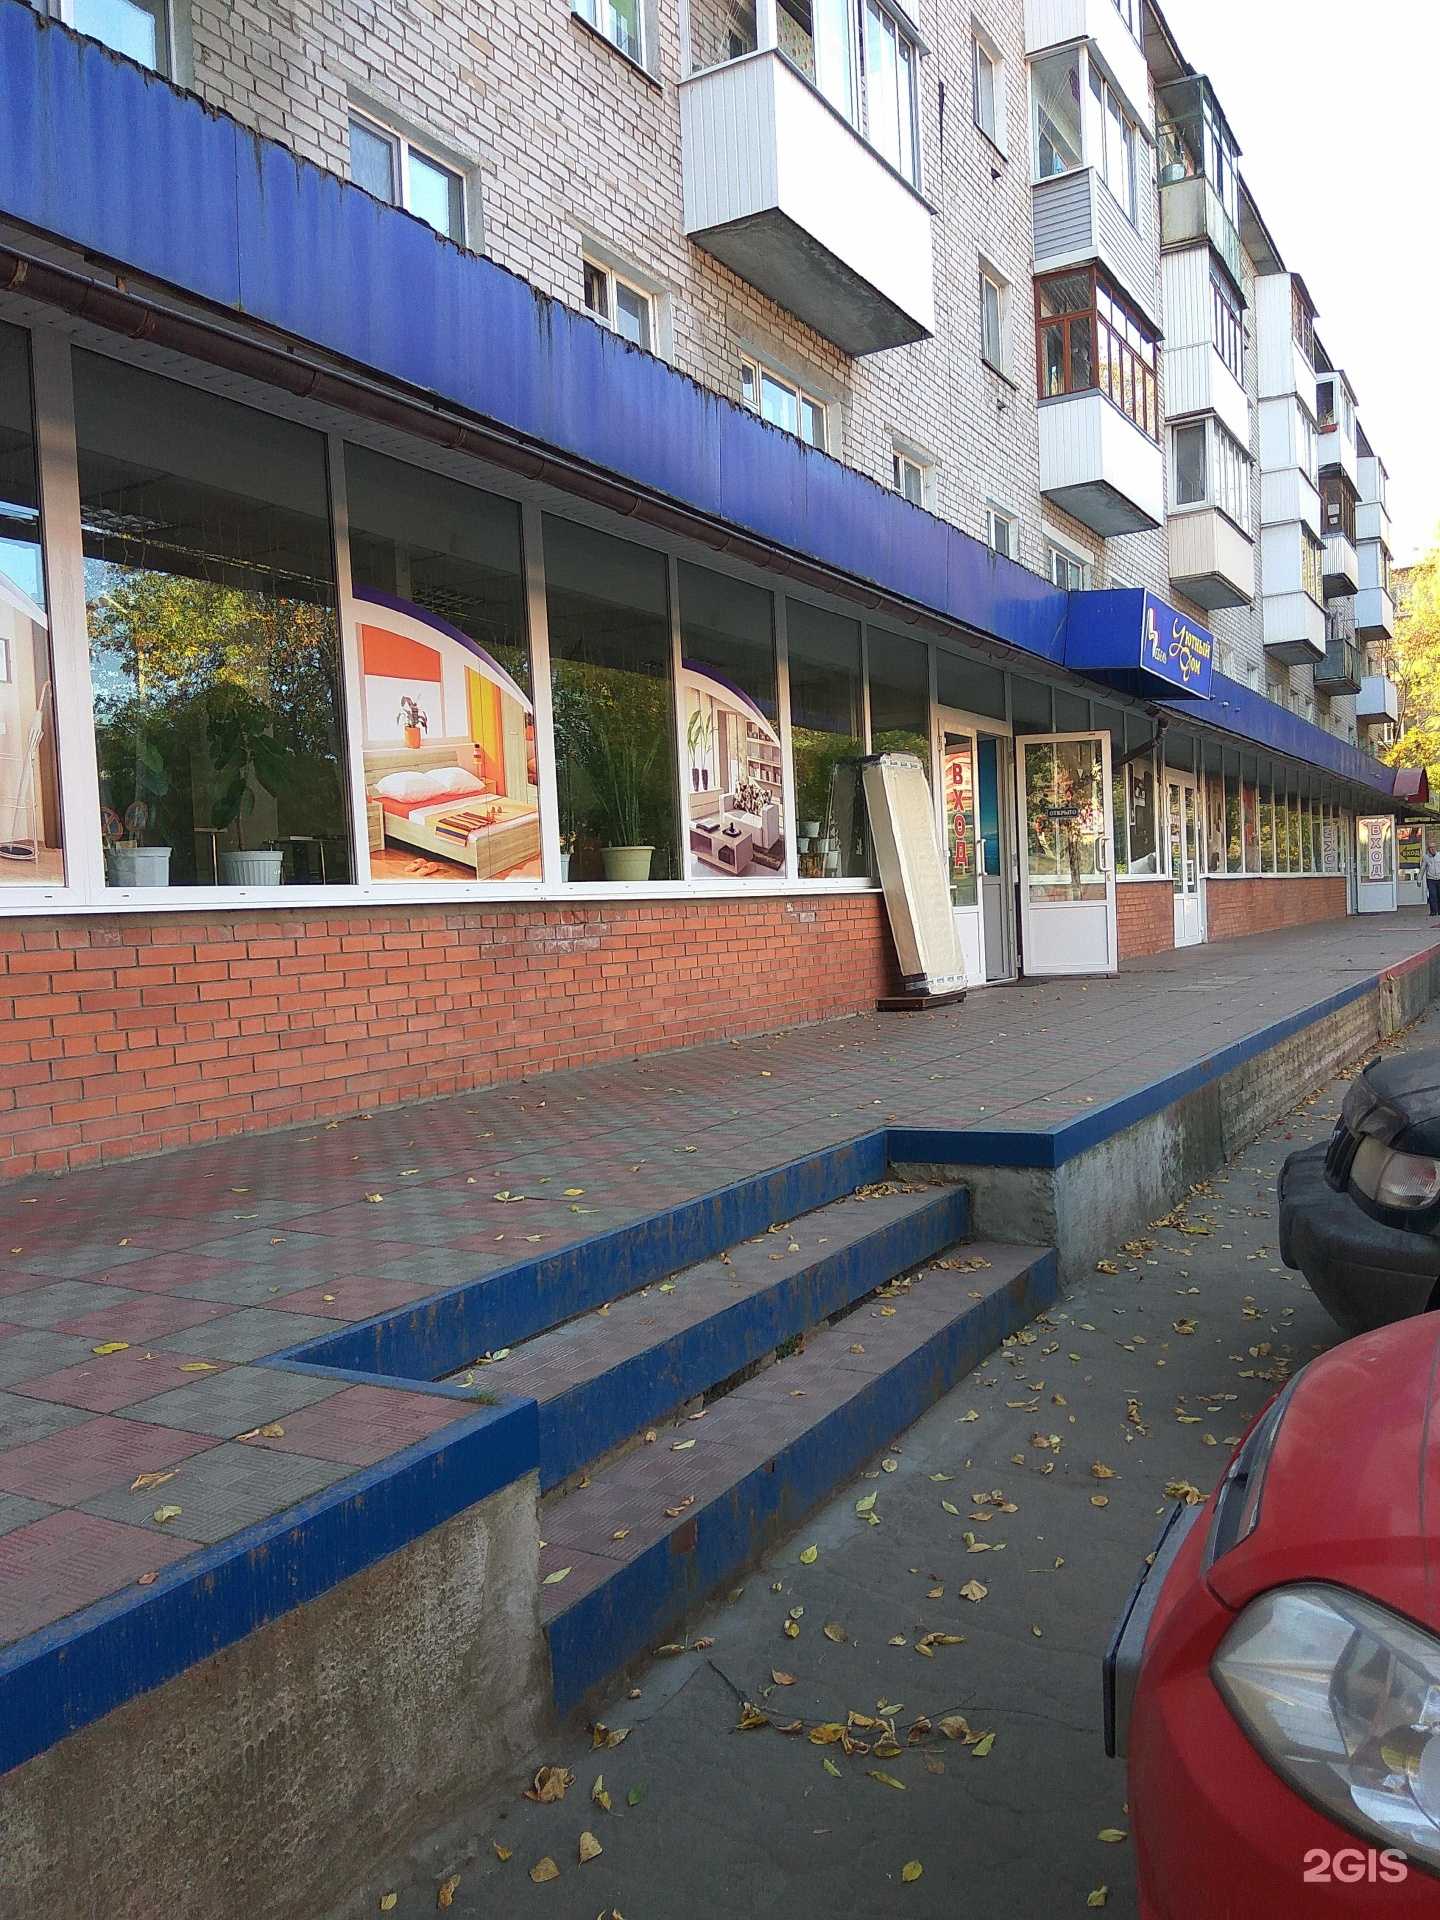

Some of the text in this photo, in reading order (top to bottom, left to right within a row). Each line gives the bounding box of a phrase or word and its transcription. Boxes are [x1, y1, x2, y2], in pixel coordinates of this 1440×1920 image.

[952, 763, 969, 869] ВХОД
[1049, 809, 1077, 817] ОТКРЫТО
[1370, 824, 1383, 877] ВХОД
[1402, 849, 1421, 857] ВХОД
